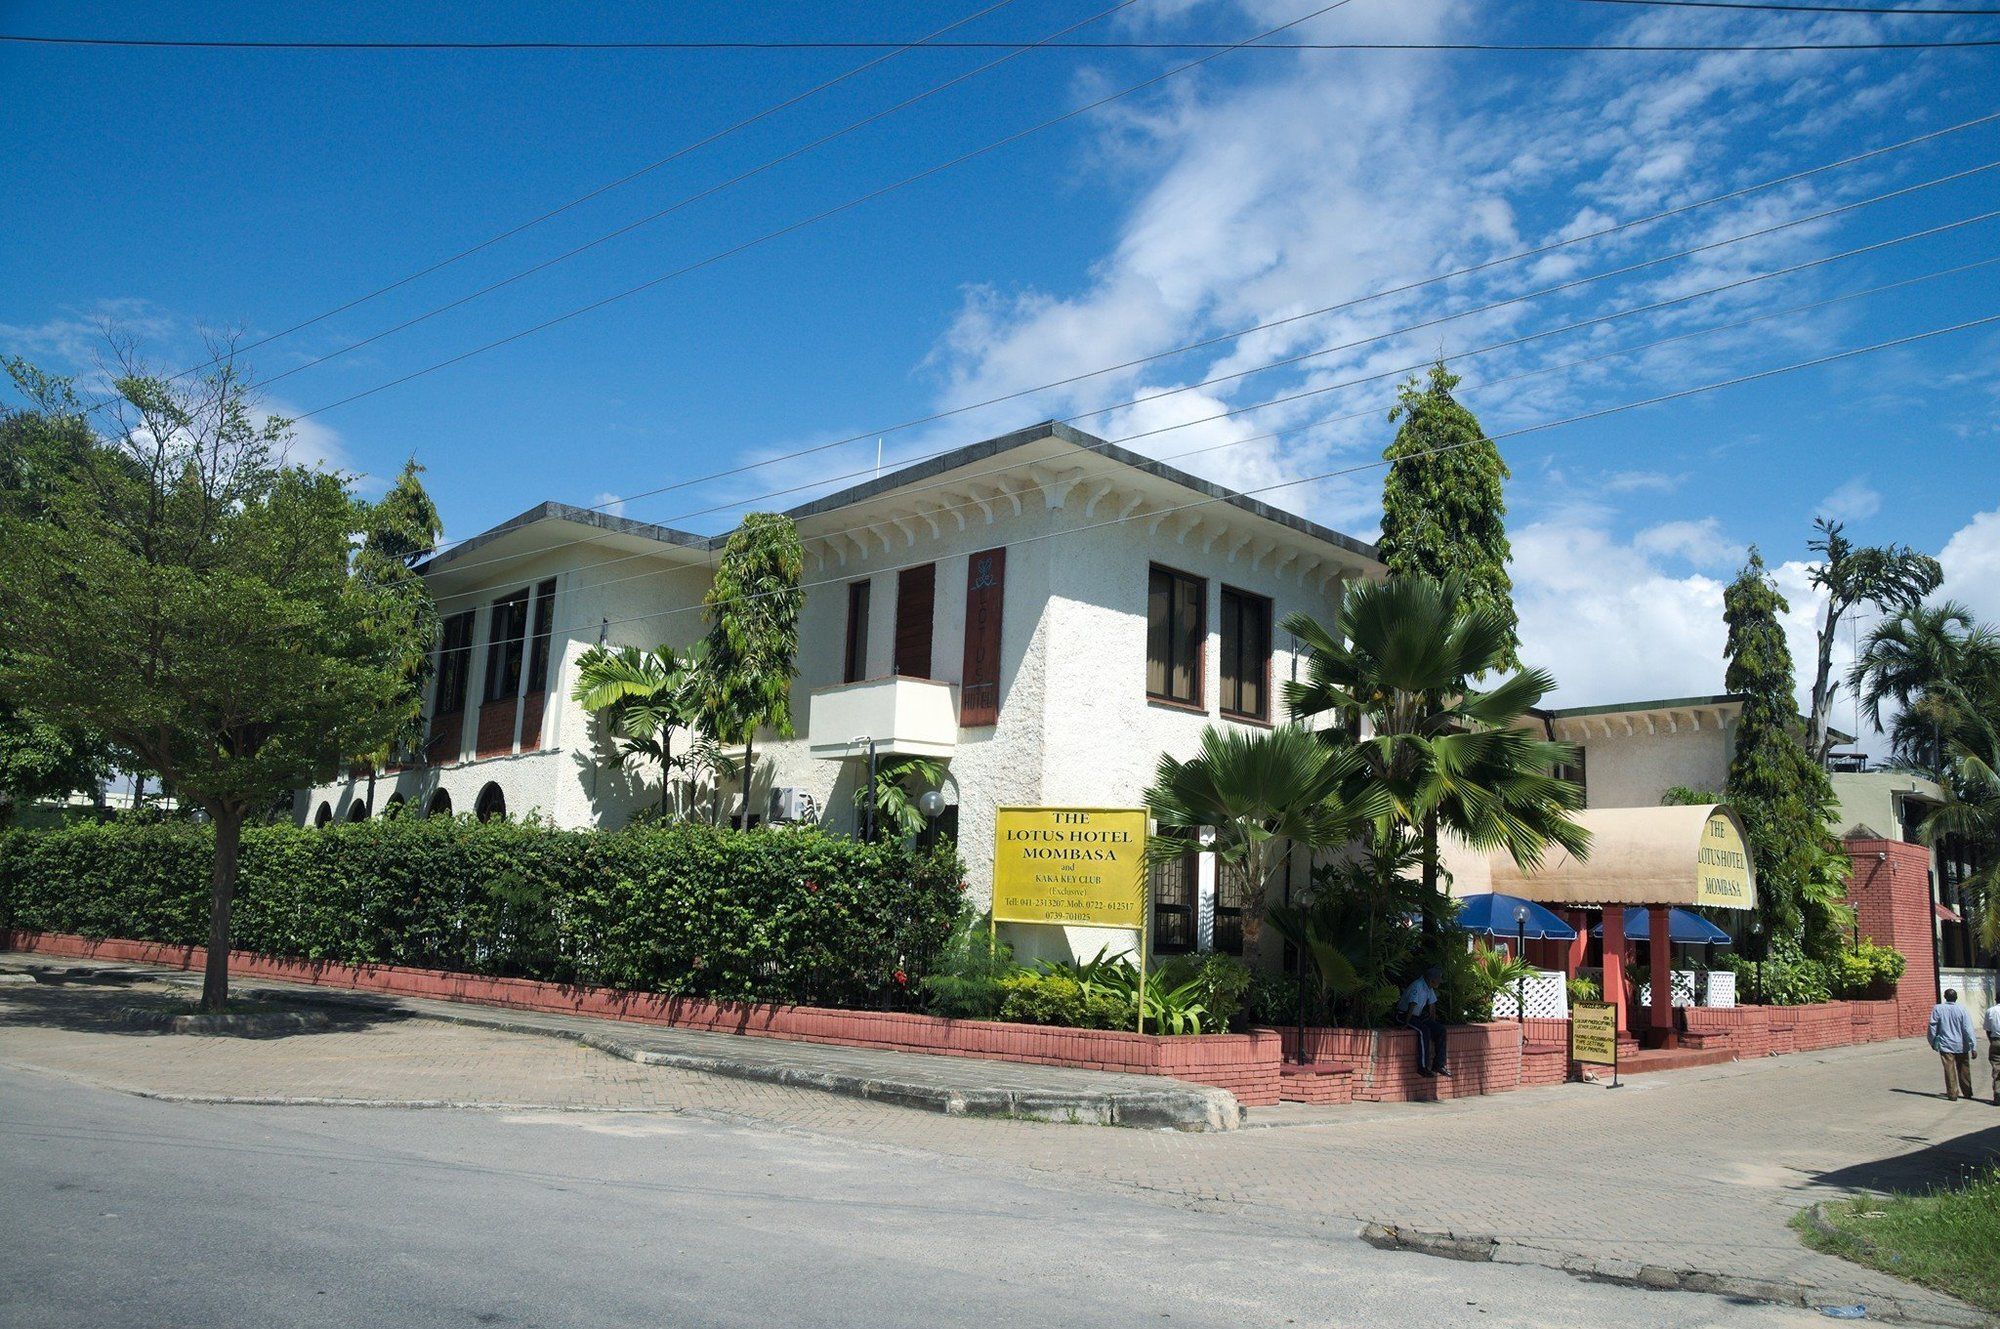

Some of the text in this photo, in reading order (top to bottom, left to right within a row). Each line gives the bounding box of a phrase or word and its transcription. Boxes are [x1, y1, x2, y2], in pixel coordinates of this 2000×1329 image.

[975, 589, 987, 683] LOTUS
[963, 691, 993, 711] HOTEL
[1052, 812, 1090, 824] THE
[1007, 829, 1133, 843] LOTUS HOTEL
[1709, 820, 1725, 839] THE
[1023, 847, 1117, 861] MOMBASA
[1061, 863, 1075, 871] and
[1035, 874, 1102, 885] KAKA KEY CLUB
[1704, 876, 1742, 897] MOMBASA
[1049, 887, 1087, 896] (Exclusive)
